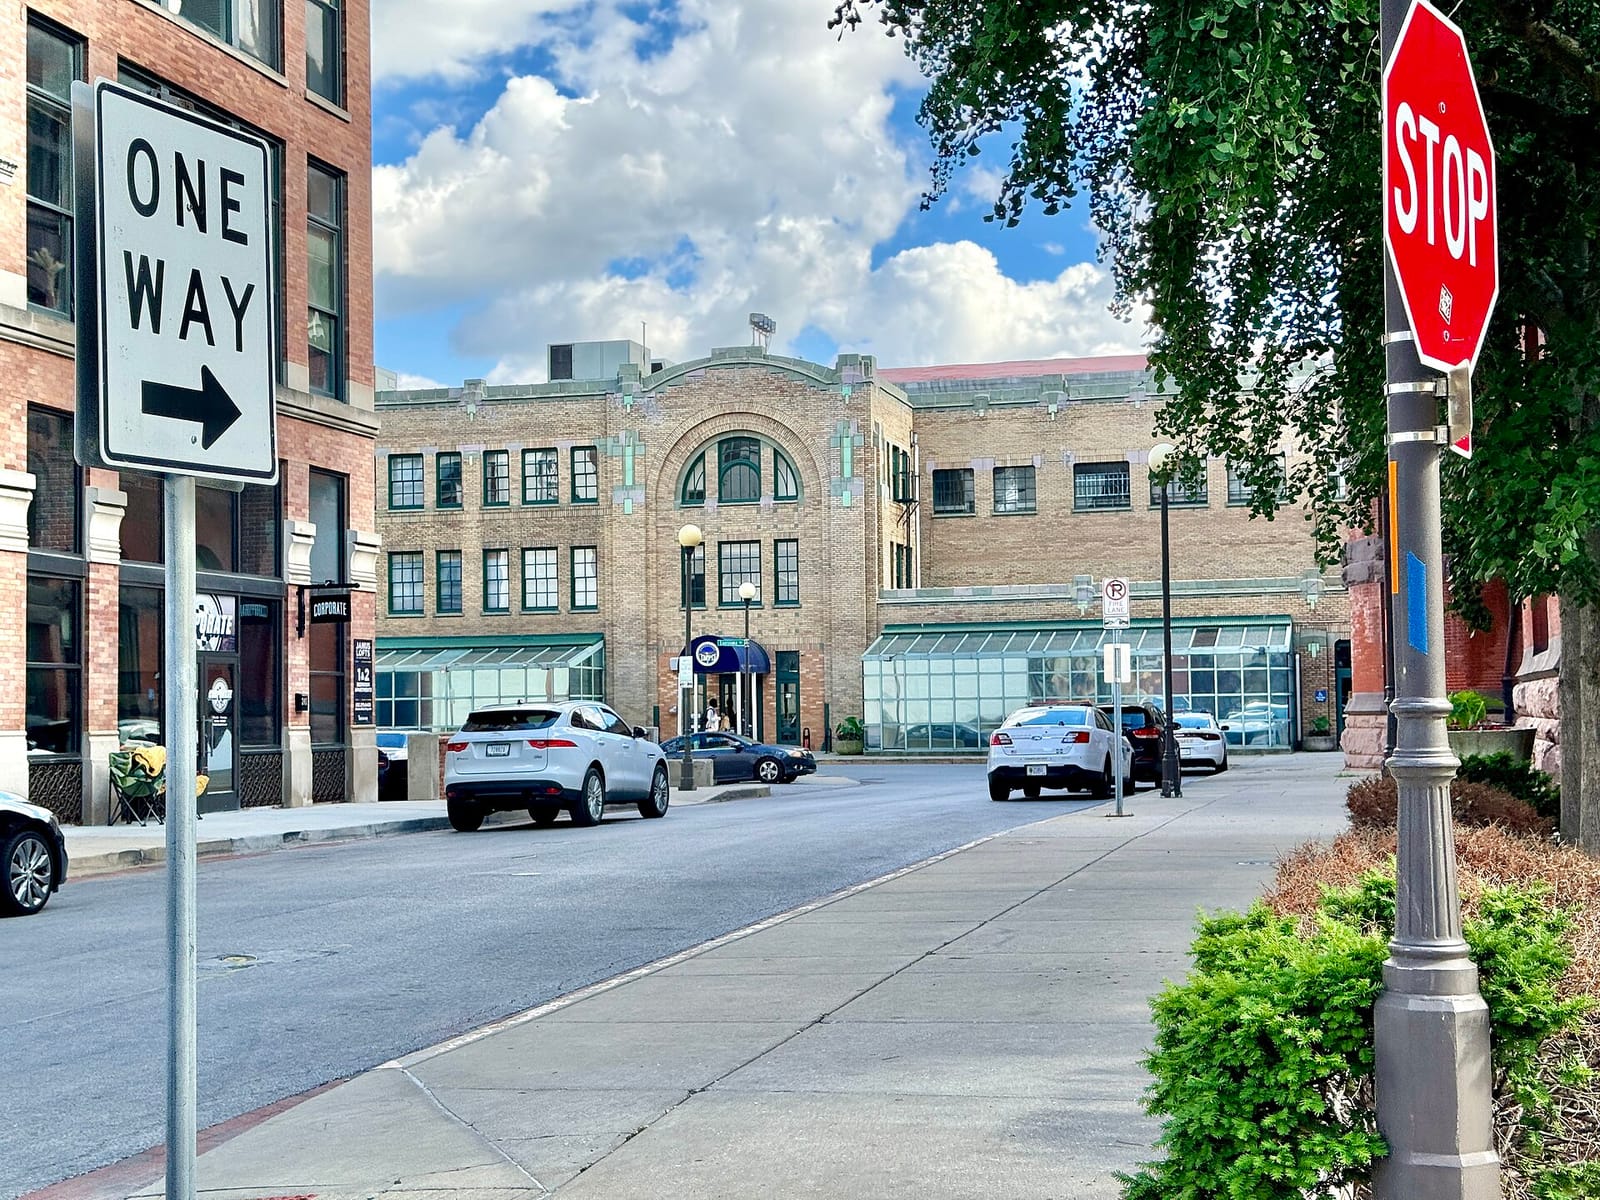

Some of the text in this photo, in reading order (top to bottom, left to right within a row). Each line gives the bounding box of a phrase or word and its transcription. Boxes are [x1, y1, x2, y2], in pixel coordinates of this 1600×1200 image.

[126, 137, 249, 247] ONE
[1394, 101, 1488, 268] STOP
[123, 249, 256, 353] WAY
[196, 614, 233, 635] PORATE
[313, 601, 347, 617] CORPORATE
[355, 648, 370, 658] LOFTS
